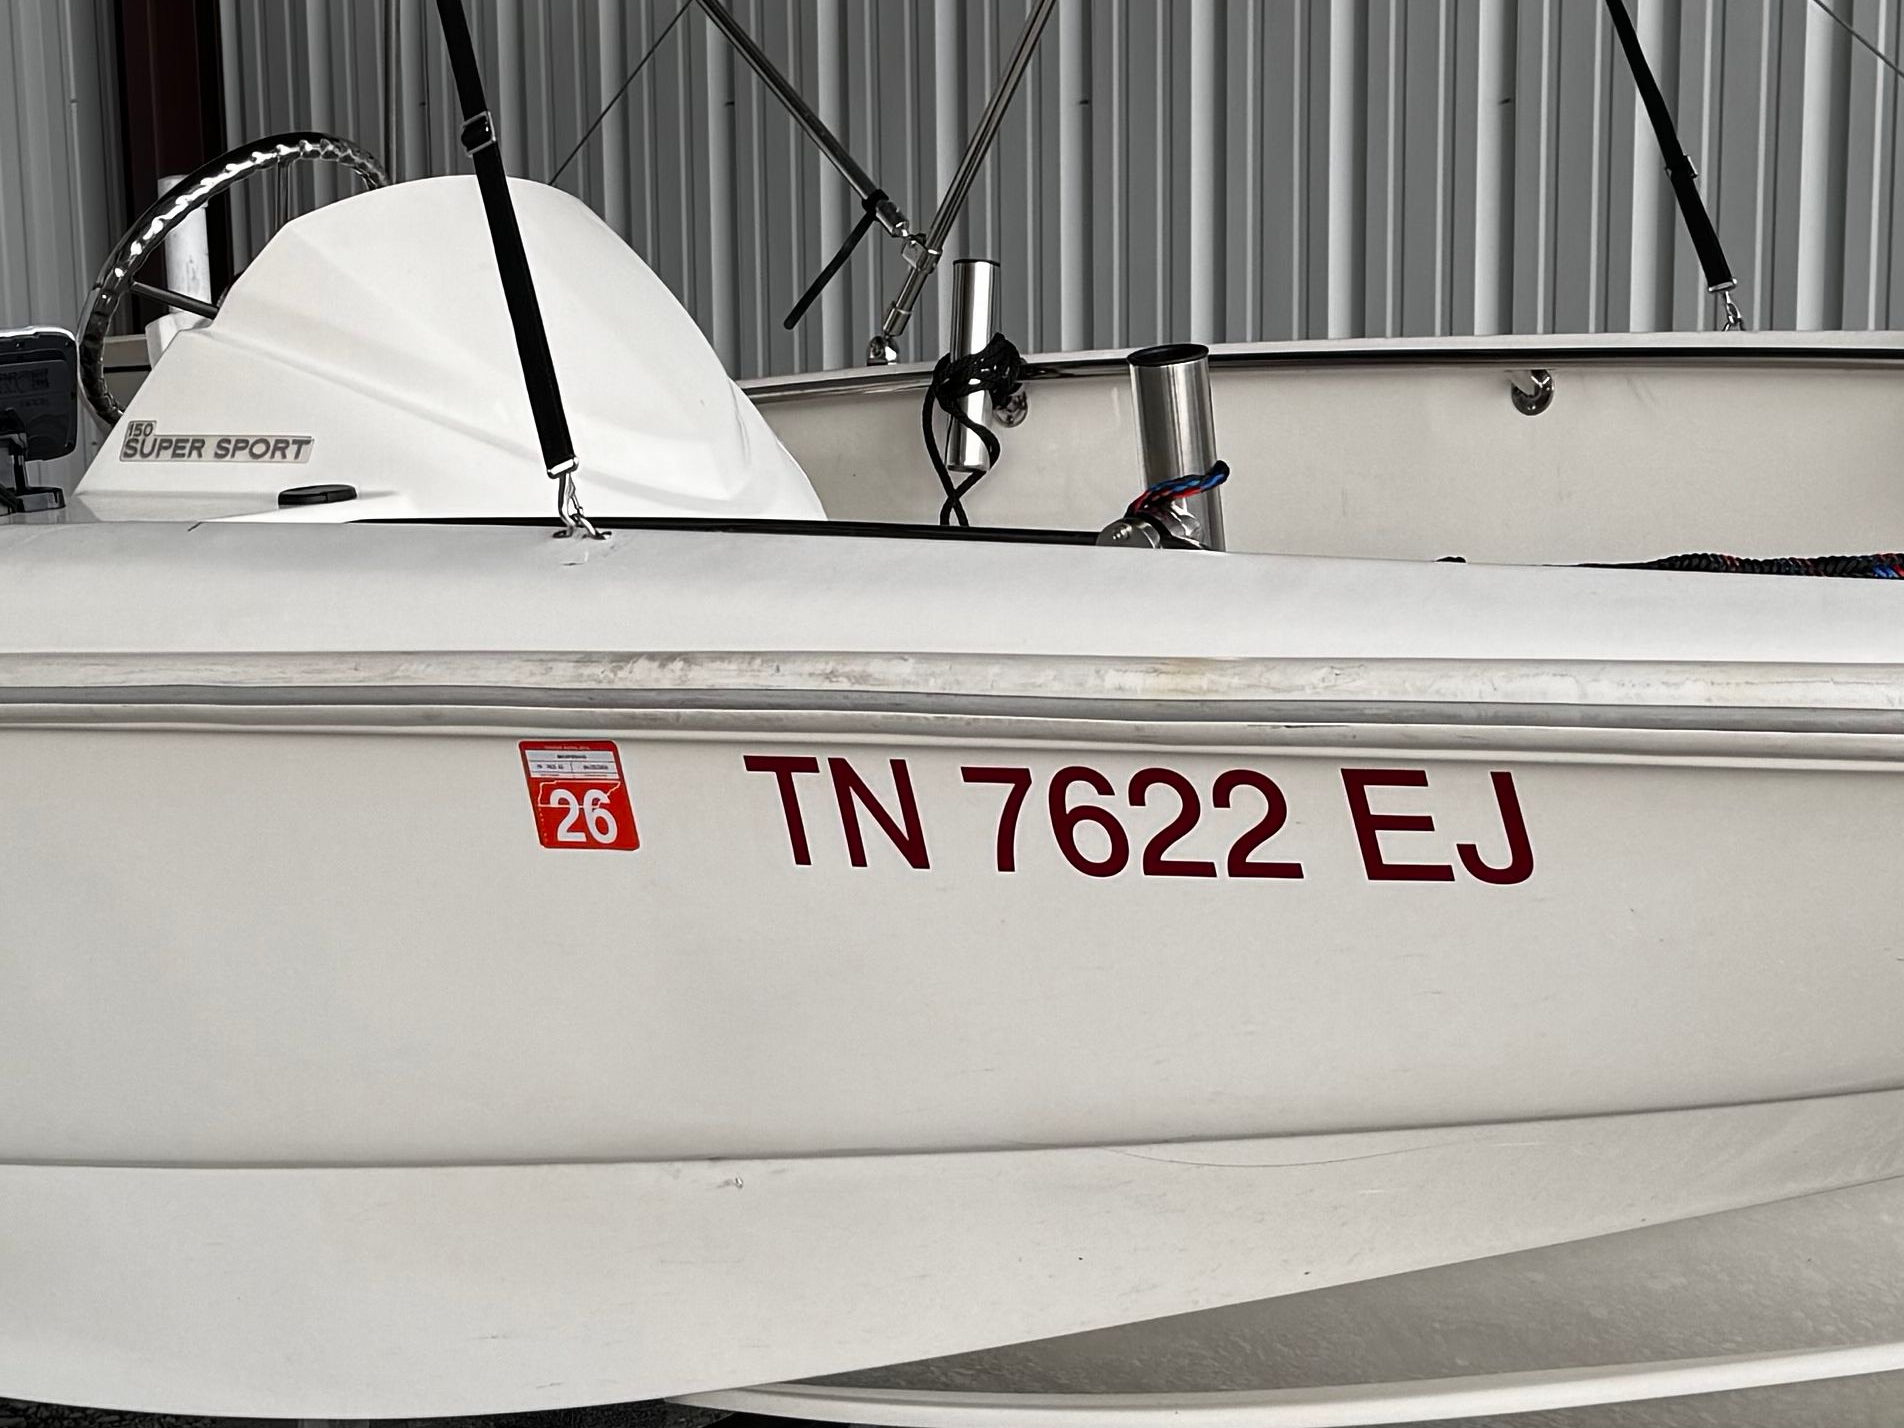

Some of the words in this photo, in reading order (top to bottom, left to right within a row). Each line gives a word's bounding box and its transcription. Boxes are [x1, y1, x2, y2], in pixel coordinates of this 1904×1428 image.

[123, 438, 206, 459] SUPER
[214, 438, 312, 460] SPORT
[128, 423, 154, 437] 150
[549, 788, 618, 844] 26
[743, 754, 932, 871] TN
[960, 765, 1305, 880] 7622
[1340, 766, 1537, 885] EJ
